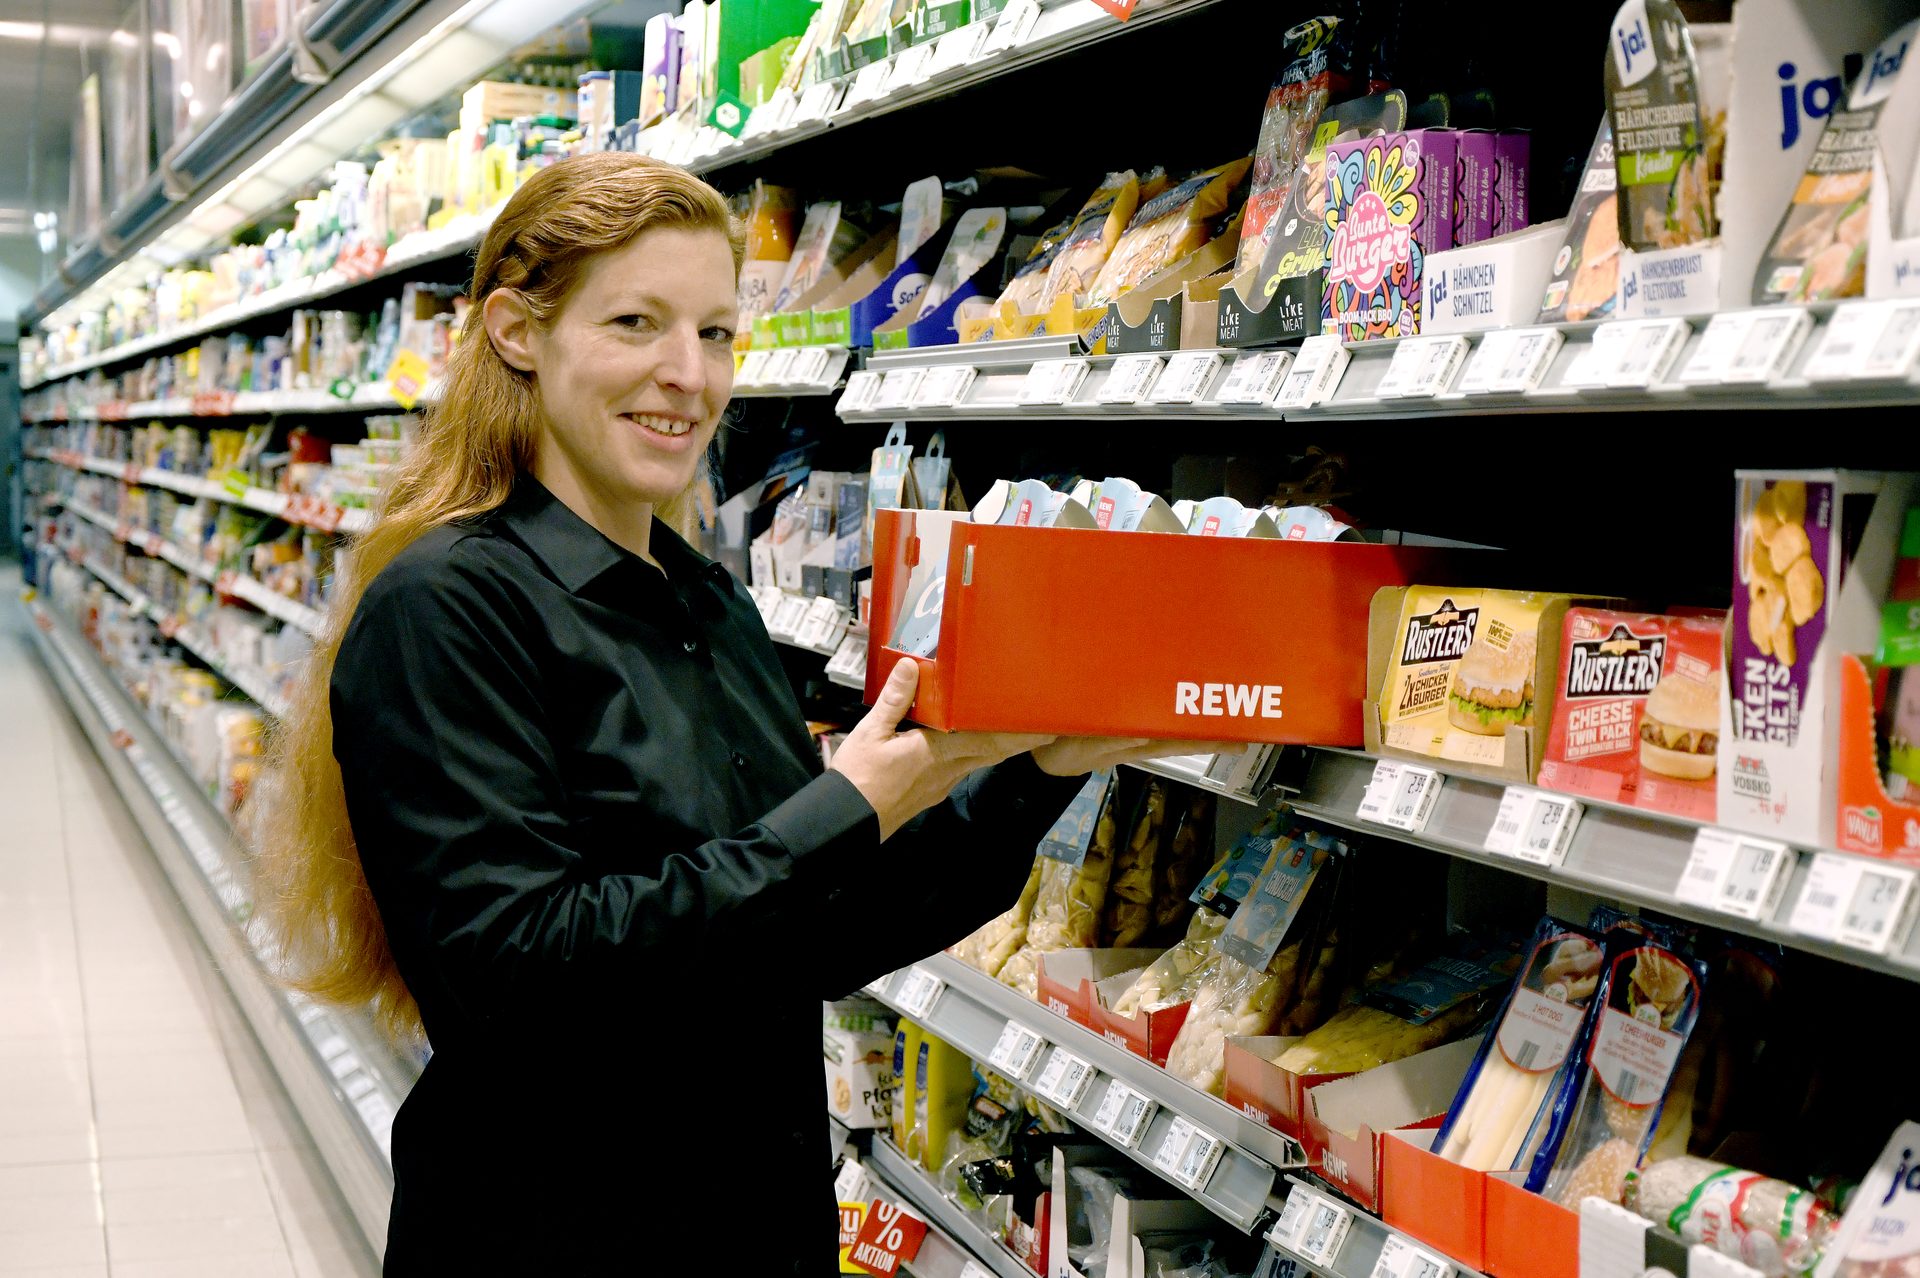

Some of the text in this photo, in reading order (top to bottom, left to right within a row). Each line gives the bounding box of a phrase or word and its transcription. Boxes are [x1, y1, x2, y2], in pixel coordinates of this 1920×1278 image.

[1618, 20, 1647, 73] ja!
[1615, 102, 1697, 131] HÄHNCHENBRUS
[1350, 212, 1386, 241] Bunte
[1331, 229, 1409, 277] Burger
[1453, 263, 1496, 291] HÄHNCHEN
[1429, 271, 1447, 321] ja!
[1453, 292, 1494, 317] SCHNITZEL
[1282, 317, 1304, 332] MEAT
[1339, 313, 1360, 324] BOOM
[1377, 309, 1393, 322] BBQ
[1107, 337, 1119, 348] MEAT
[1150, 335, 1164, 346] MEAT
[1220, 328, 1240, 339] MEAT
[1404, 611, 1478, 662] RUSTLERS
[1570, 642, 1663, 693] RUSTLERS
[1415, 672, 1449, 692] CHICKEN
[1175, 681, 1283, 719] REWE
[1413, 686, 1447, 707] BURGER
[1570, 700, 1633, 731] CHEESE
[1570, 721, 1632, 747] TWIN PACK
[1733, 775, 1771, 794] VOSSKO
[1321, 1147, 1349, 1185] REWE
[853, 1241, 897, 1273] AKTION
